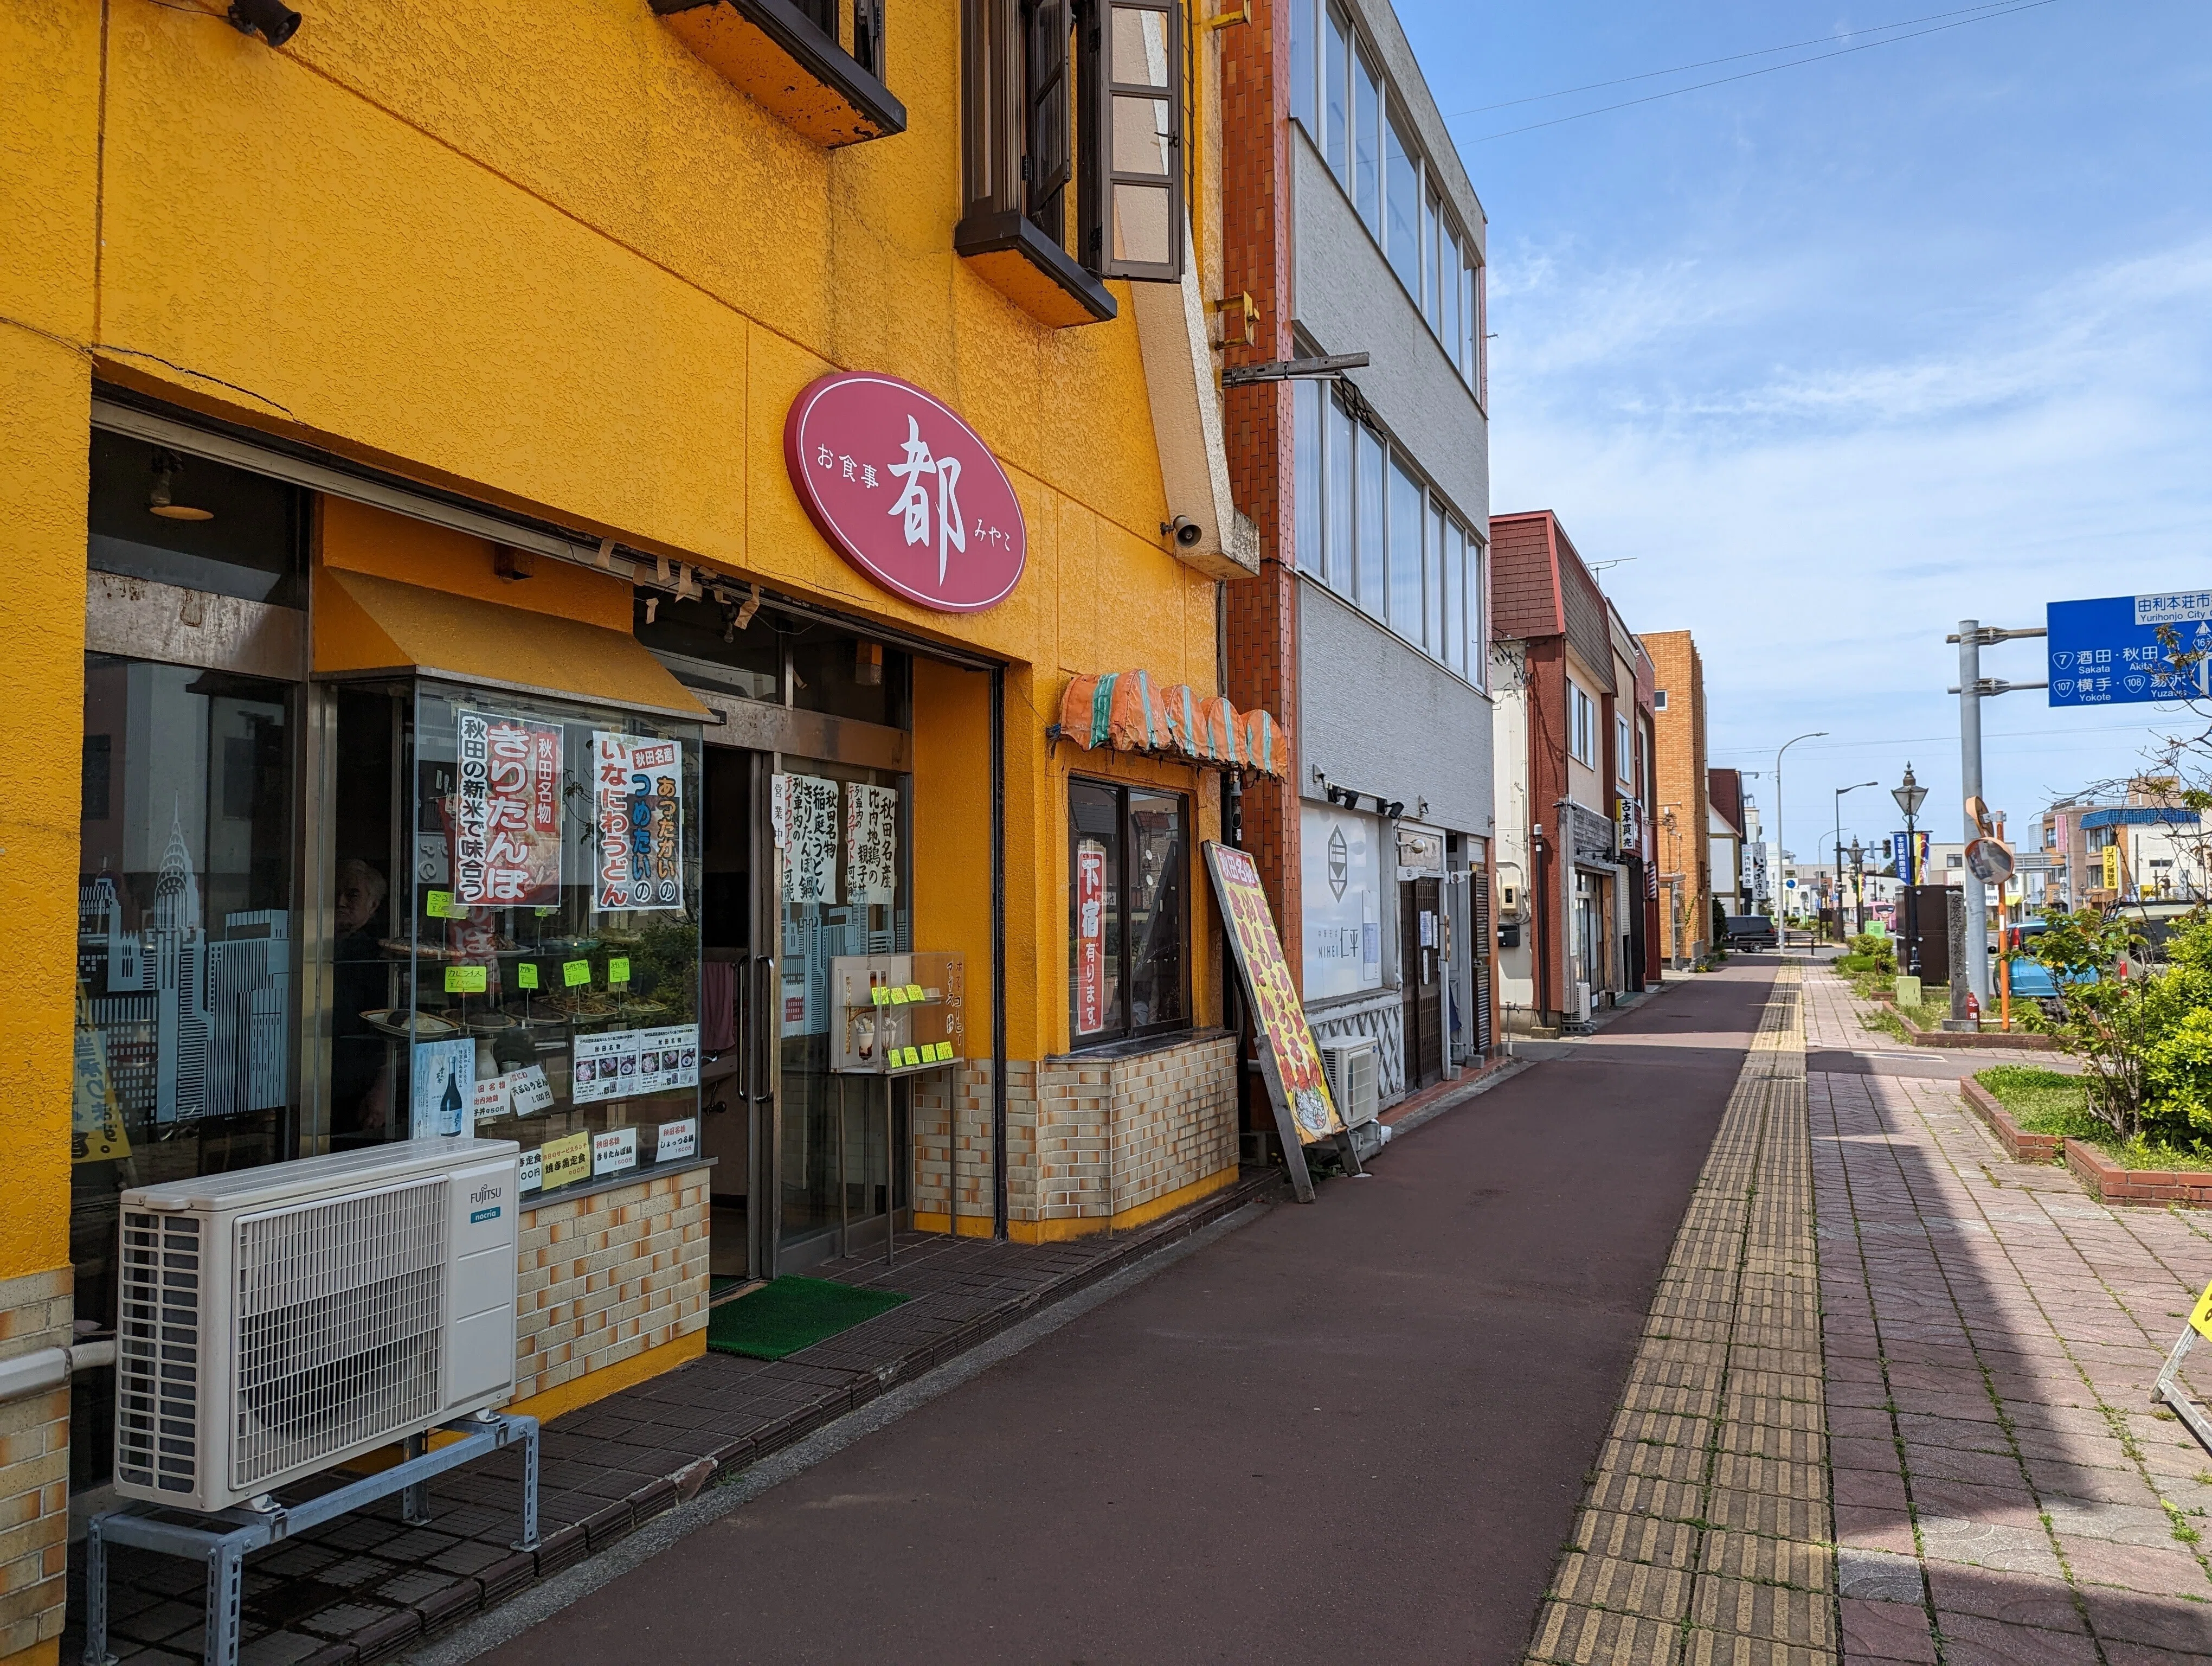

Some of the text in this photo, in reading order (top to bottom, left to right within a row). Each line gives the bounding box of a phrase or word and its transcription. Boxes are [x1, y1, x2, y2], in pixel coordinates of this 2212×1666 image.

[818, 444, 879, 489] お食事
[888, 414, 966, 587] 都
[974, 518, 1011, 552] みやこ
[2138, 593, 2212, 612] 由利本荘市
[2140, 612, 2183, 622] Yurihonjo
[2187, 611, 2205, 619] City
[2057, 682, 2069, 691] 107
[2127, 677, 2141, 687] 108
[2079, 694, 2111, 702] Yokote
[635, 748, 674, 768] 秋田名産
[537, 738, 555, 824] 秋田名物
[461, 718, 487, 900] 秋田の新米で味合う
[600, 740, 627, 907] いなにわうどん
[774, 784, 783, 842] 営業中
[793, 777, 803, 841] 列車内の
[824, 790, 837, 858] 秋田名物
[854, 785, 864, 829] 列車内の
[632, 774, 651, 903] つめたいの
[813, 785, 826, 896] 稲庭うどん
[867, 788, 881, 885] 比内地鶏の
[879, 797, 895, 888] 秋田名産
[857, 843, 868, 902] 親子丼
[1219, 851, 1255, 884] 秋田名物
[2106, 848, 2115, 887] リオン補聴器
[1319, 945, 1338, 958] NIHEI
[1340, 927, 1358, 958] 仁平
[596, 1137, 620, 1149] 秋田名物
[663, 1125, 686, 1137] 秋田名物
[545, 1153, 586, 1175] 焼き魚定食
[615, 1157, 633, 1165] 1500円
[675, 1145, 692, 1154] 1500円
[471, 1184, 501, 1204] FUJITSU
[475, 1210, 496, 1221] nocria
